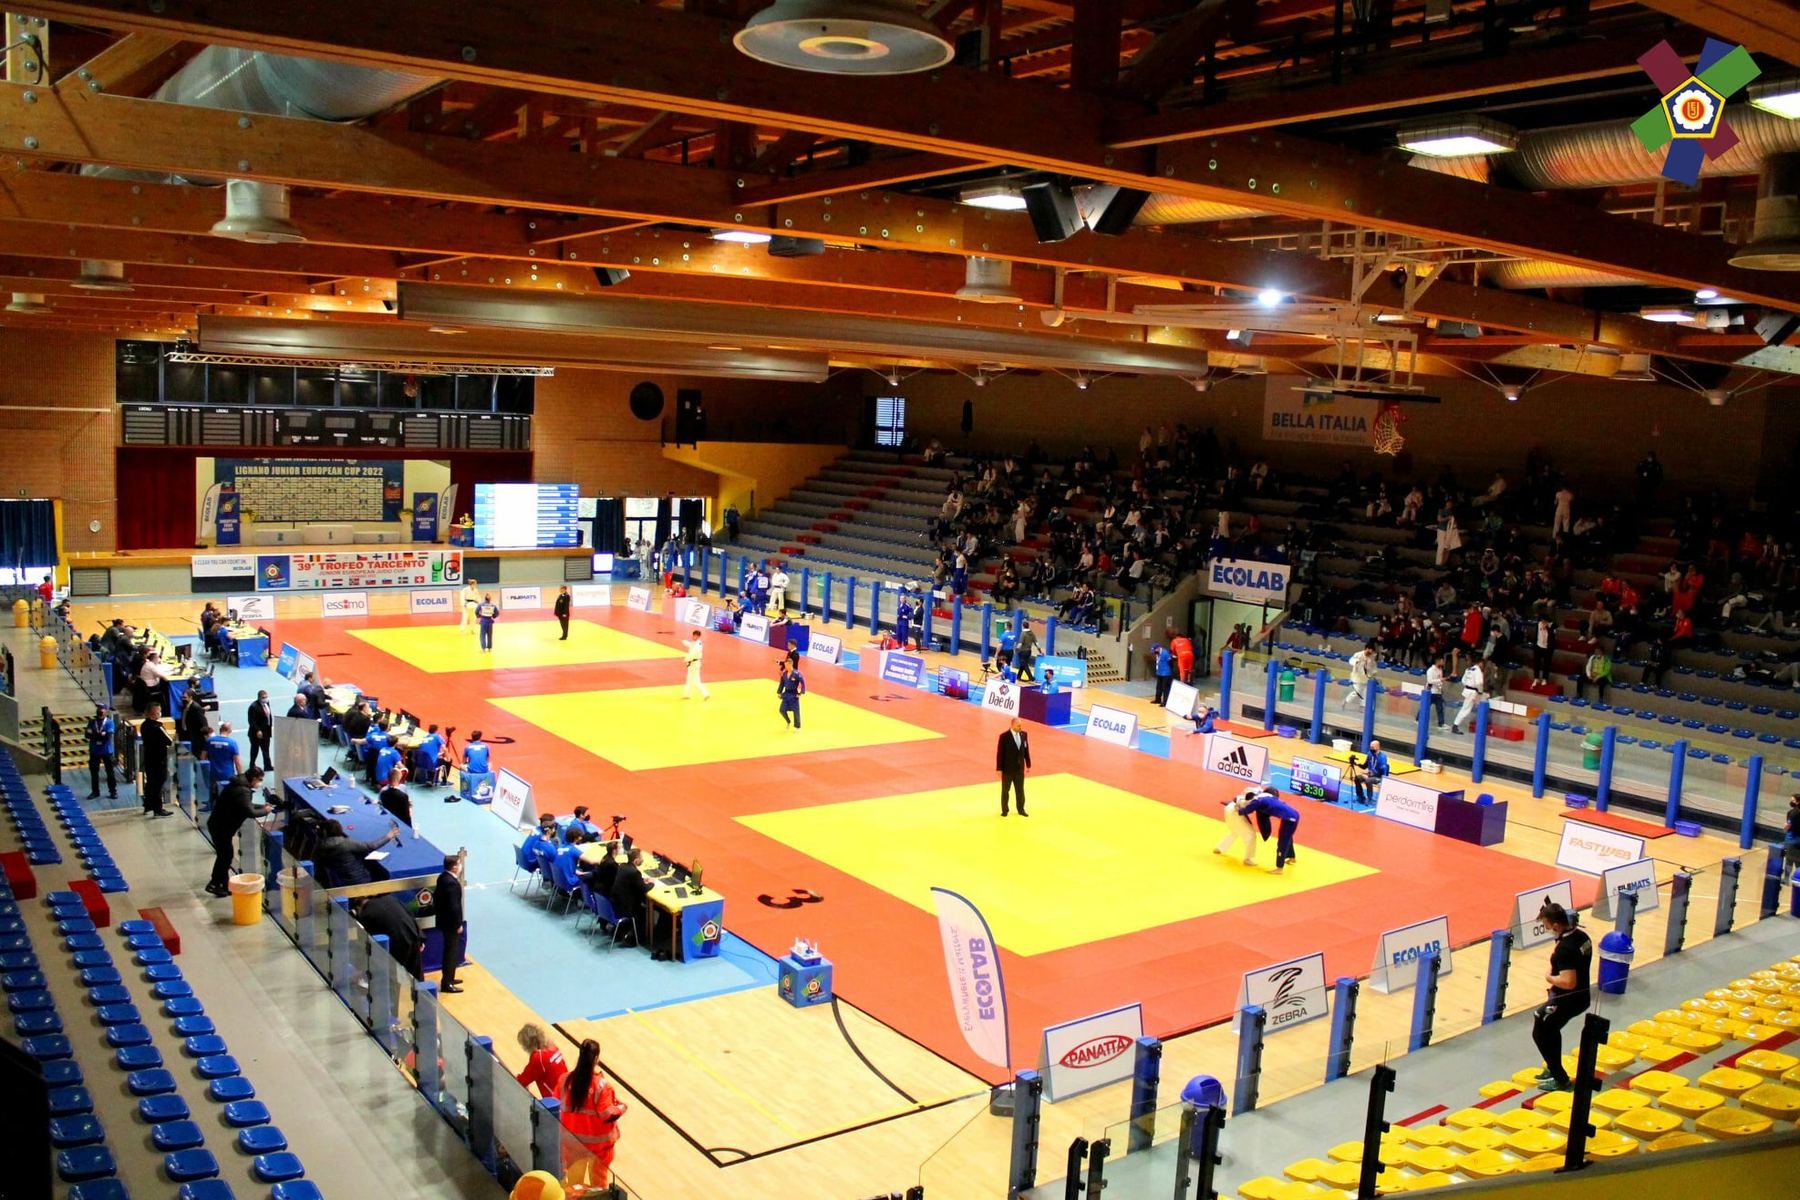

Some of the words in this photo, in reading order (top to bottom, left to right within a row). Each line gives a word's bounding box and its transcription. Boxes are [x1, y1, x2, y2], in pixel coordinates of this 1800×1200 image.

[1271, 412, 1315, 429] BELLA
[1319, 414, 1367, 432] ITALIA
[235, 465, 269, 475] LIGNANO
[271, 466, 300, 475] JUNIOR
[302, 466, 342, 475] EUROPEAN
[344, 467, 360, 475] CUP
[362, 467, 383, 475] 2022
[319, 561, 364, 570] TROFEO
[367, 559, 426, 569] TARCENTO
[1213, 564, 1284, 591] ECOLAB
[326, 599, 364, 610] essimo
[416, 597, 447, 606] ECOLAB
[812, 642, 834, 654] ECOLAB
[1092, 717, 1127, 734] ECOLAB
[1217, 760, 1253, 778] adidas
[1303, 783, 1324, 797] 3:30
[1568, 837, 1632, 860] FASTWEB
[1271, 1007, 1308, 1025] ZEBRA
[1069, 1036, 1126, 1066] PANATTA
